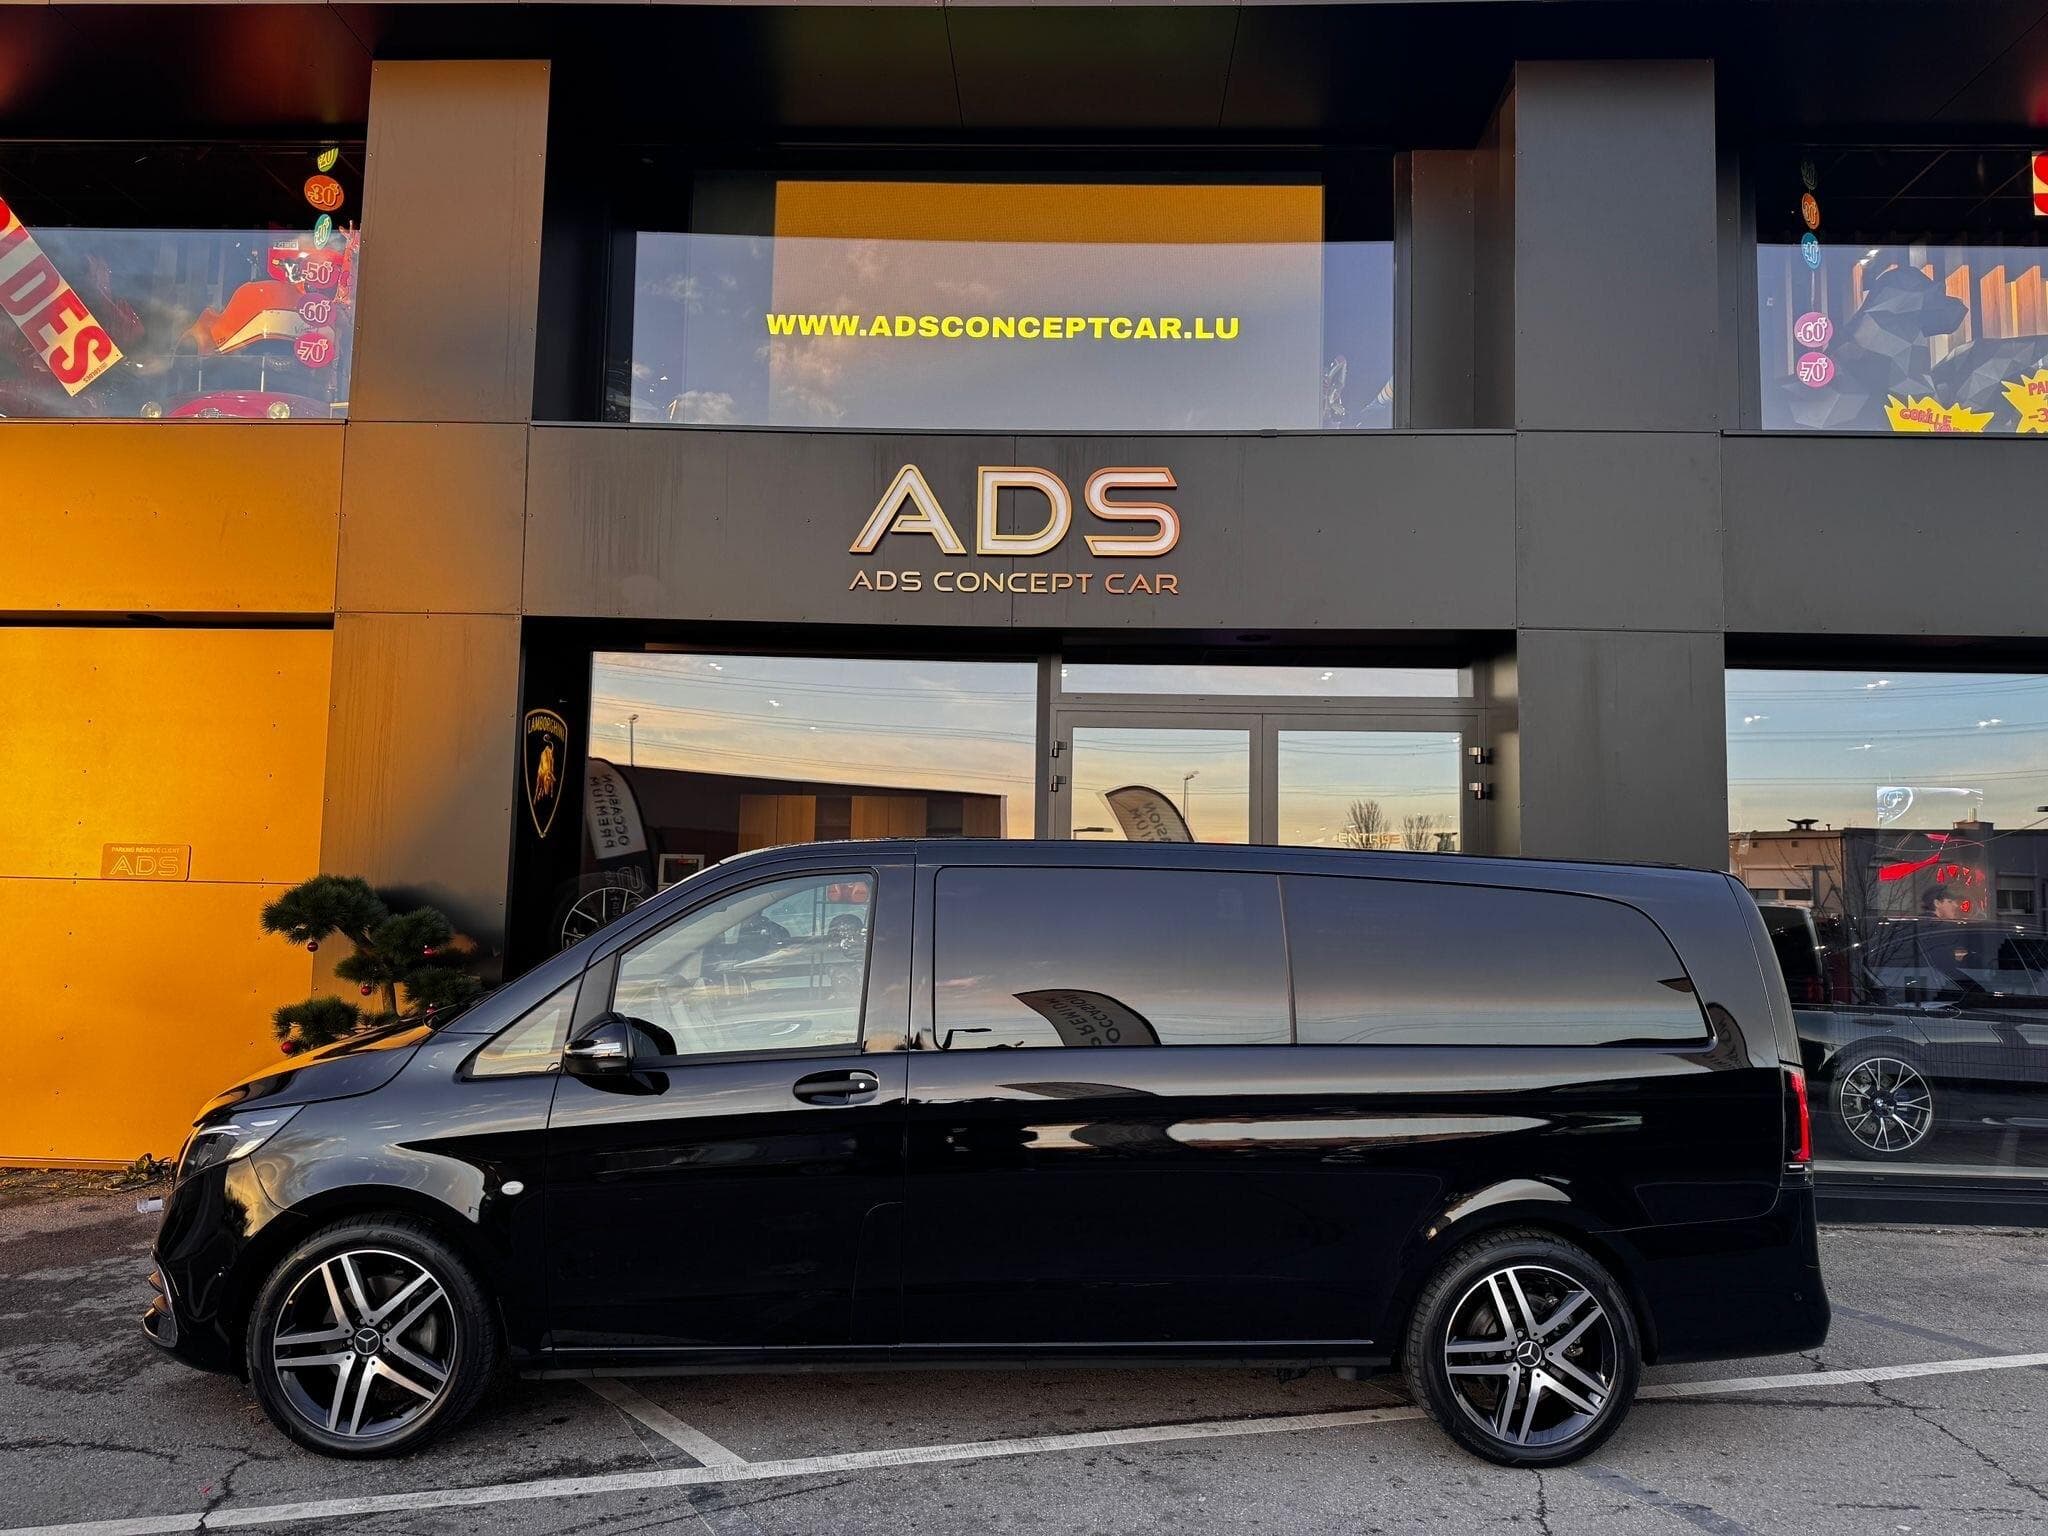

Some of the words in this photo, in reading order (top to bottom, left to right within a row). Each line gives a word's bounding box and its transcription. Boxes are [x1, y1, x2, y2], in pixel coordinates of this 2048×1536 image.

[766, 313, 1239, 340] WWW.ADSCONCEPTCAR.LU
[1797, 317, 1828, 342] -60%
[1800, 357, 1828, 382] -70%
[848, 463, 1181, 557] ADS
[848, 570, 922, 592] ADS
[933, 571, 1093, 594] CONCEPT
[1104, 573, 1180, 595] CAR
[110, 854, 179, 876] ADS
